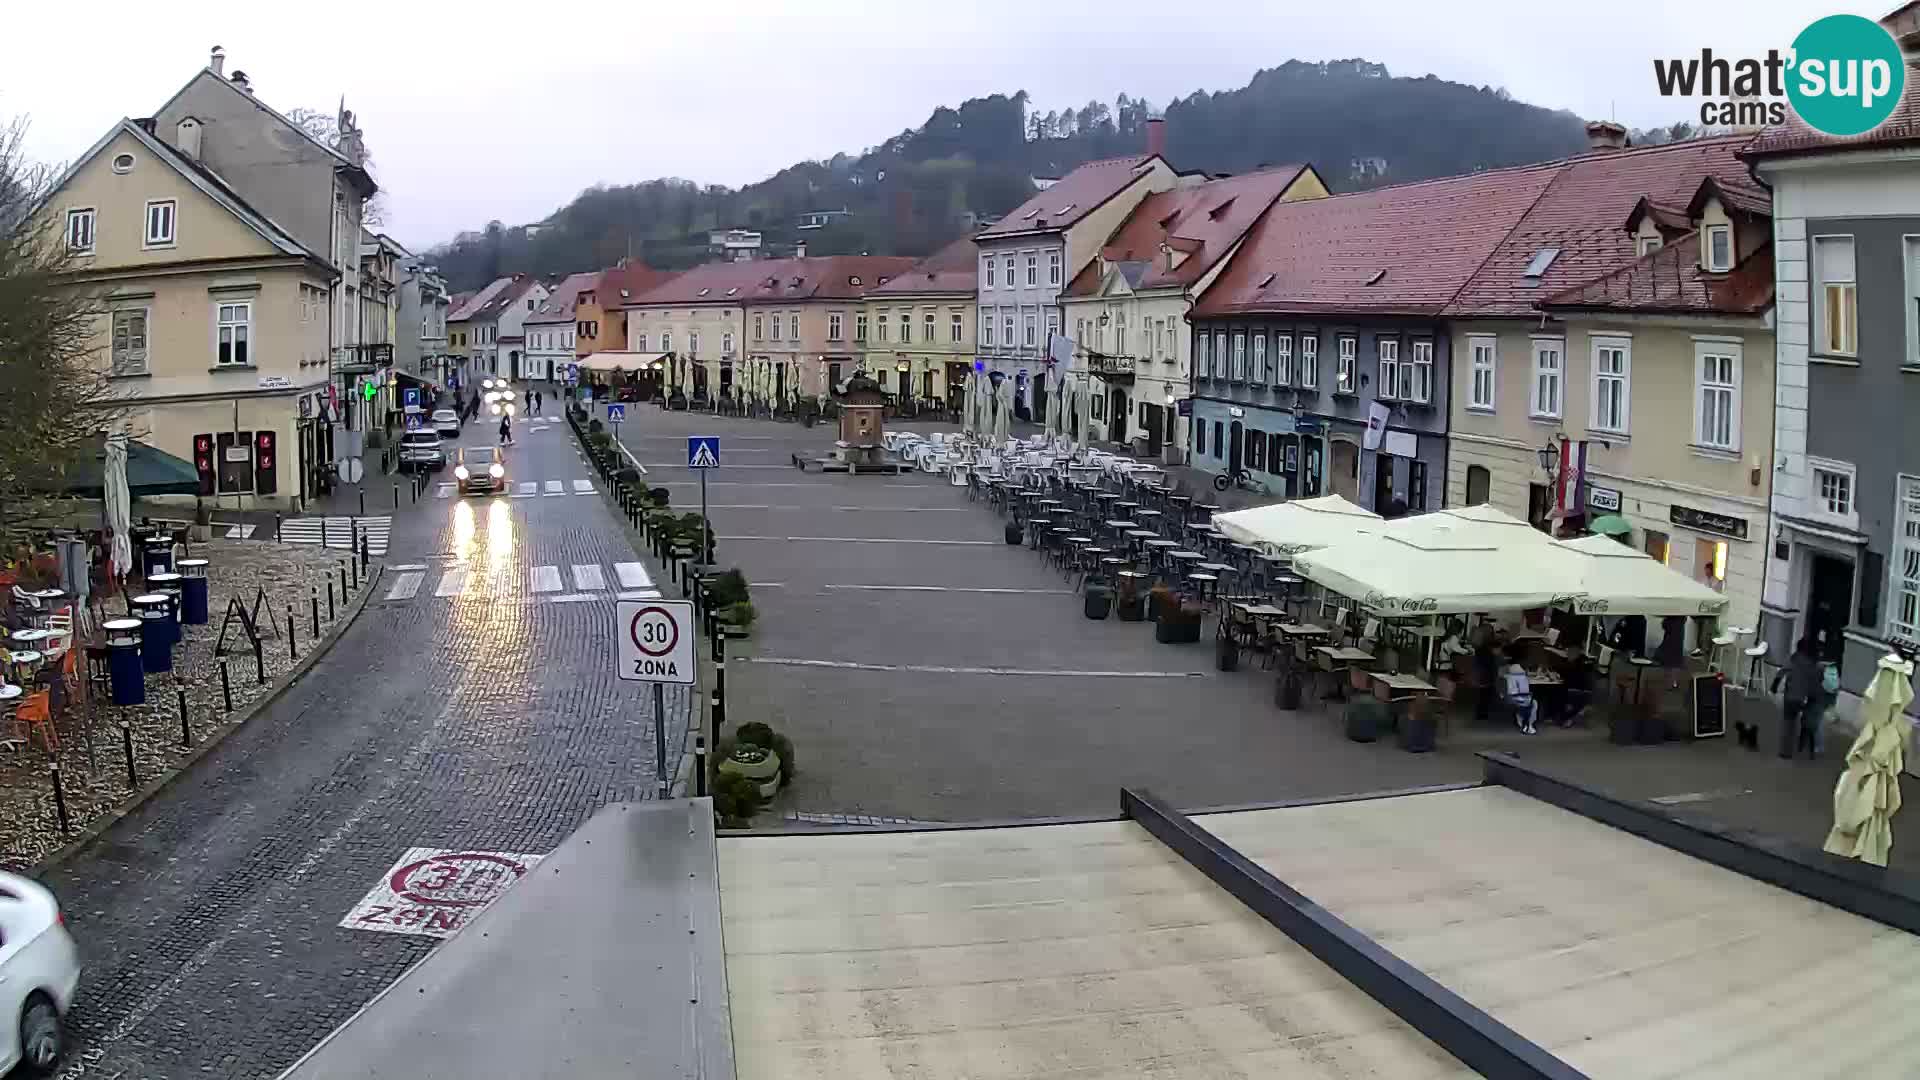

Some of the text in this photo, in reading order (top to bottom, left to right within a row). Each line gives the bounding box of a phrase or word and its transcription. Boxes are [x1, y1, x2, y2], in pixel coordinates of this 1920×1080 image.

[408, 391, 416, 402] P
[643, 622, 667, 643] 30
[634, 659, 678, 677] ZONA
[415, 865, 502, 893] 30
